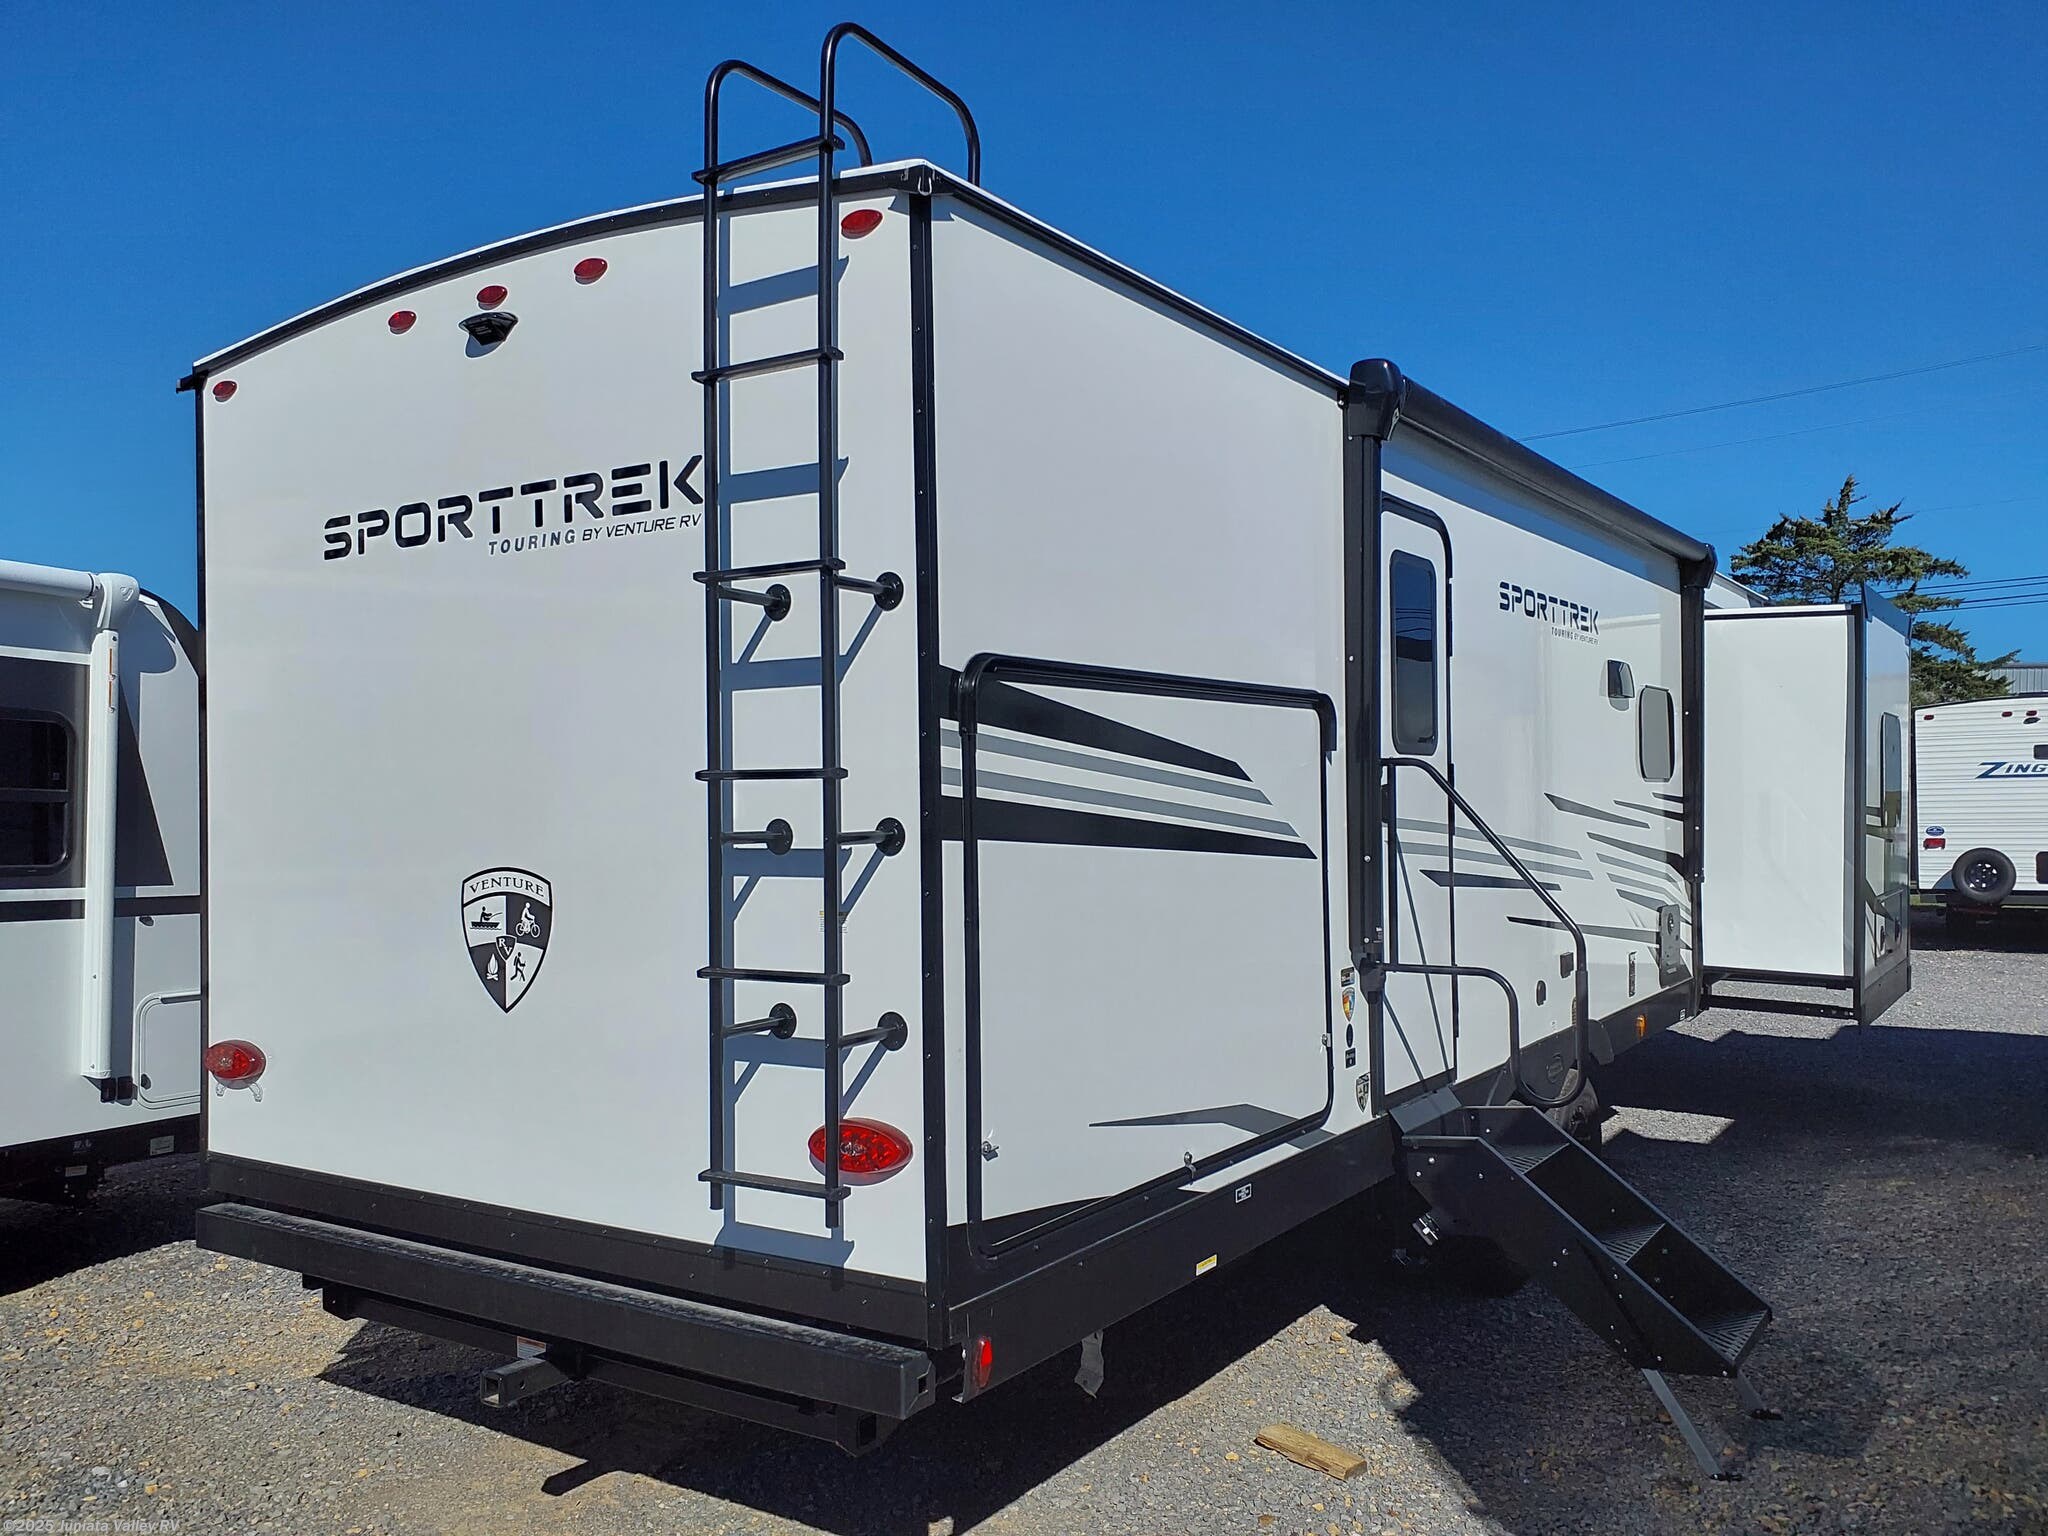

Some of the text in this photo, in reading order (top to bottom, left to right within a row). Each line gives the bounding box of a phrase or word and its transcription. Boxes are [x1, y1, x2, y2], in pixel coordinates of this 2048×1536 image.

[324, 455, 704, 560] SPORTTREK
[489, 512, 702, 555] TOURING BY VENTURE RV
[1499, 580, 1599, 635] SPORTTREK
[1551, 626, 1573, 640] TOURING
[470, 876, 544, 897] VENTURE
